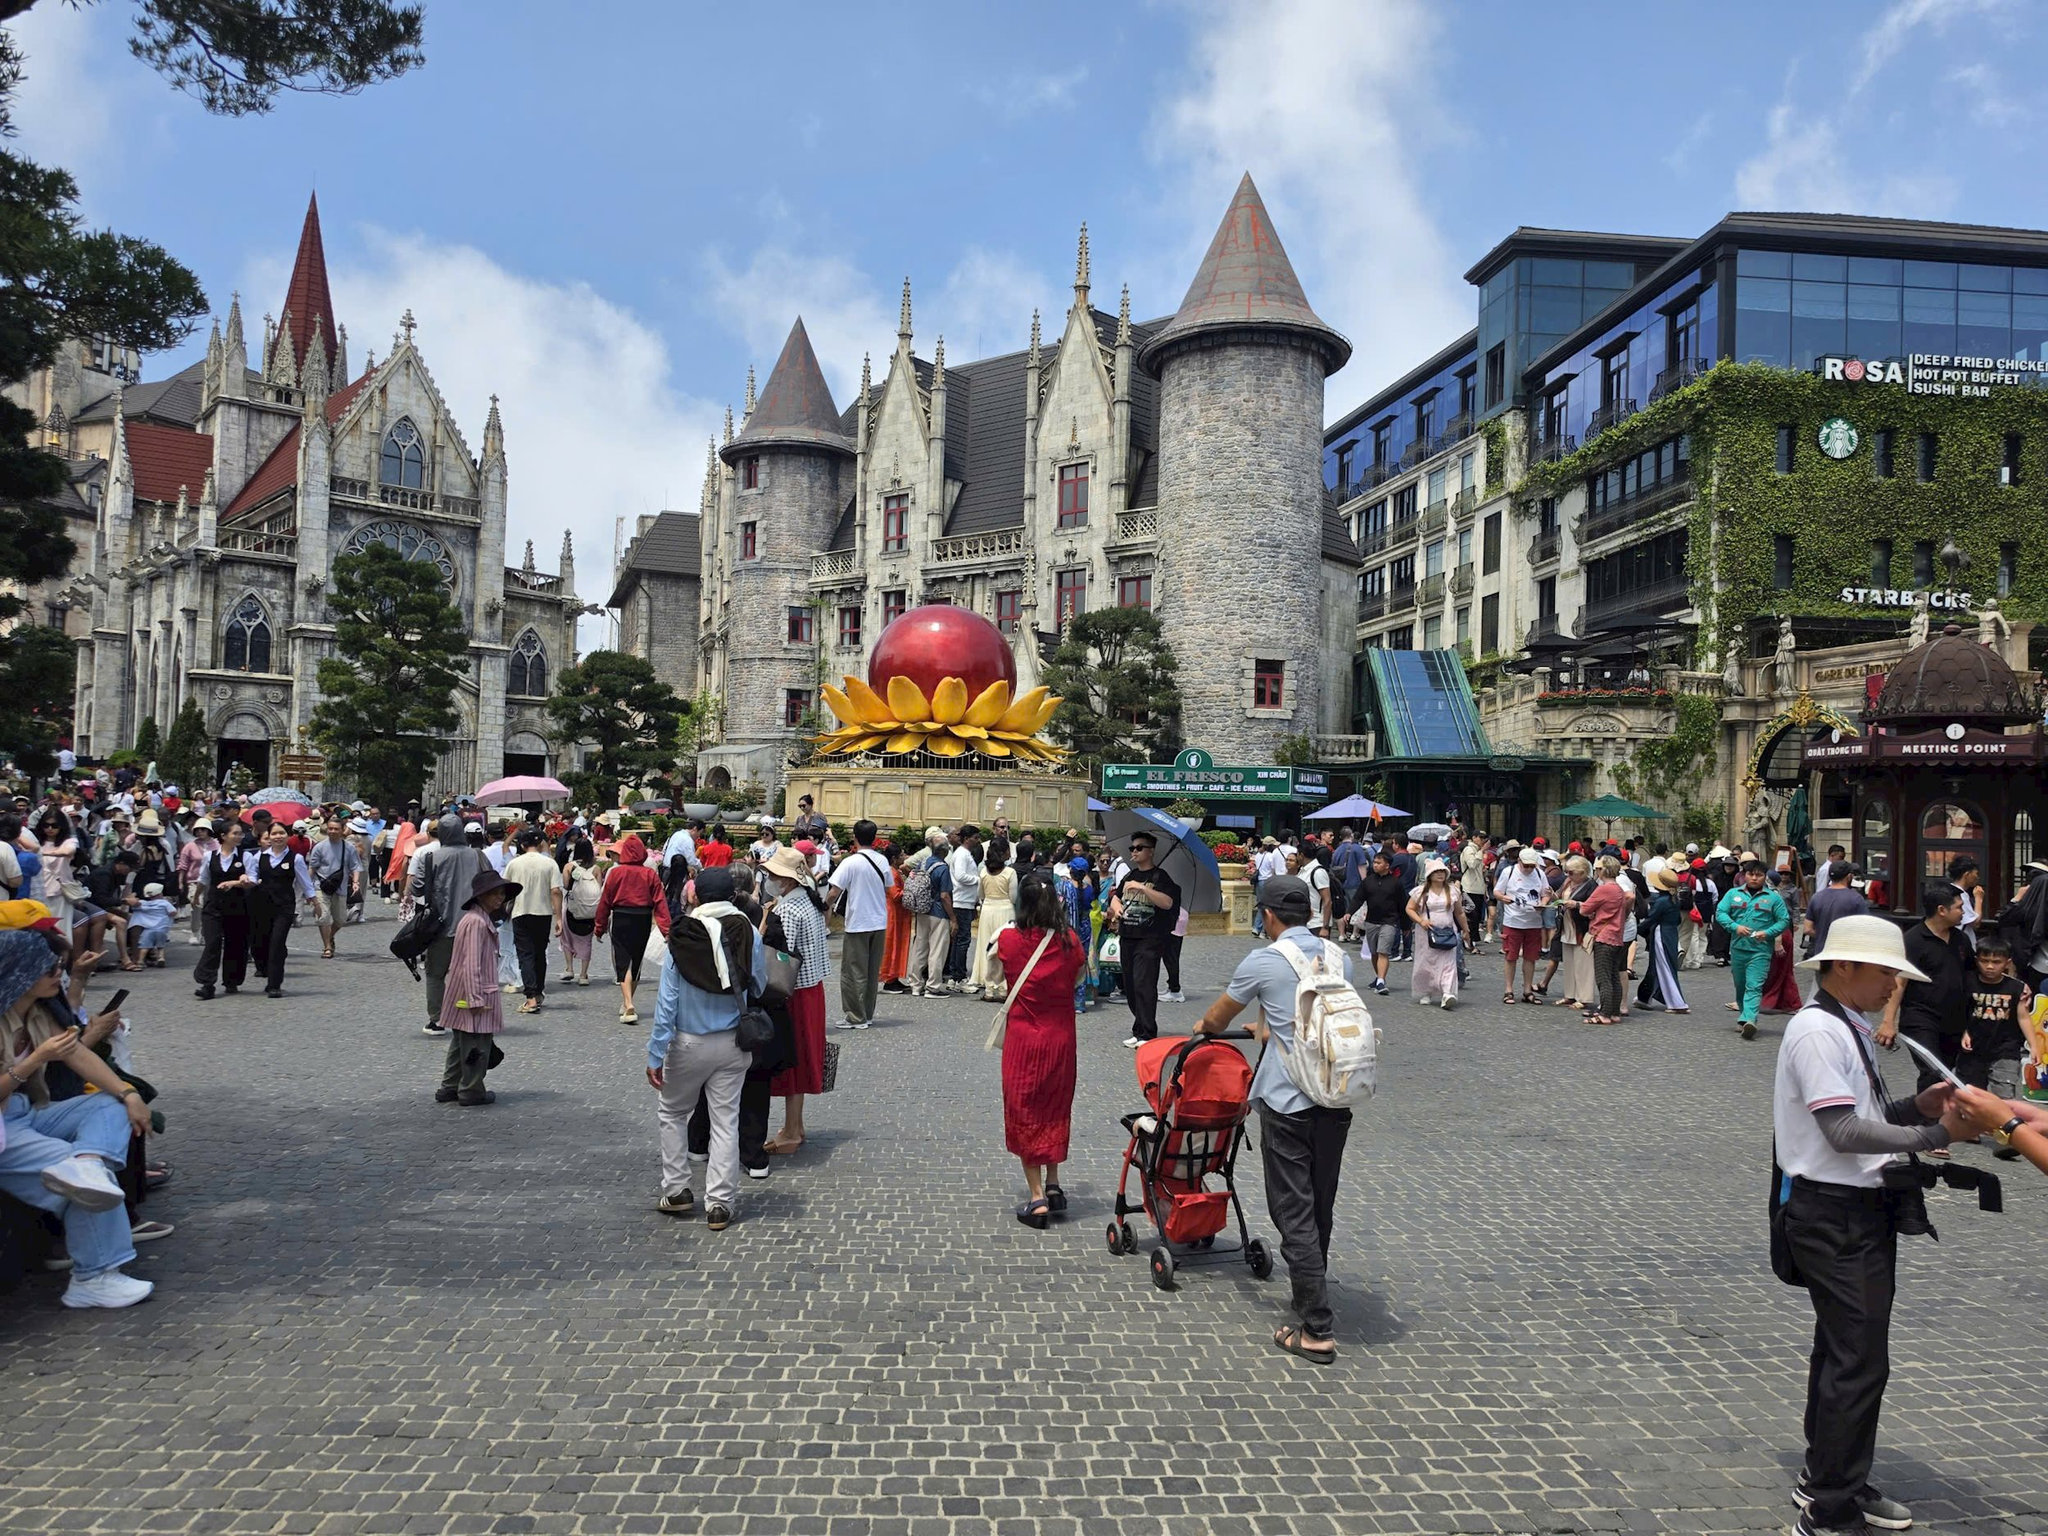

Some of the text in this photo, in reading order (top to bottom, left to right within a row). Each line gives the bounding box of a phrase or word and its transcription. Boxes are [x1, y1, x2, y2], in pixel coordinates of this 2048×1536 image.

[1914, 353, 1950, 367] DEEP
[1954, 356, 1993, 369] FRIED
[1825, 358, 1904, 384] ROSA
[1913, 368, 2020, 385] HOT POT BUFFET
[1913, 382, 1990, 398] SUSHI BAR
[1851, 745, 1863, 754] TIN
[1902, 743, 2007, 754] MEETING POINT
[1146, 770, 1168, 782] EL
[1173, 771, 1244, 783] FRESCO
[1125, 782, 1142, 790] JUICE
[1146, 783, 1180, 791] SMOOTHIES
[1186, 783, 1204, 791] FRUIT
[1231, 784, 1242, 792] ICE
[1243, 784, 1266, 792] CREAM
[1972, 992, 2012, 1007] VIET
